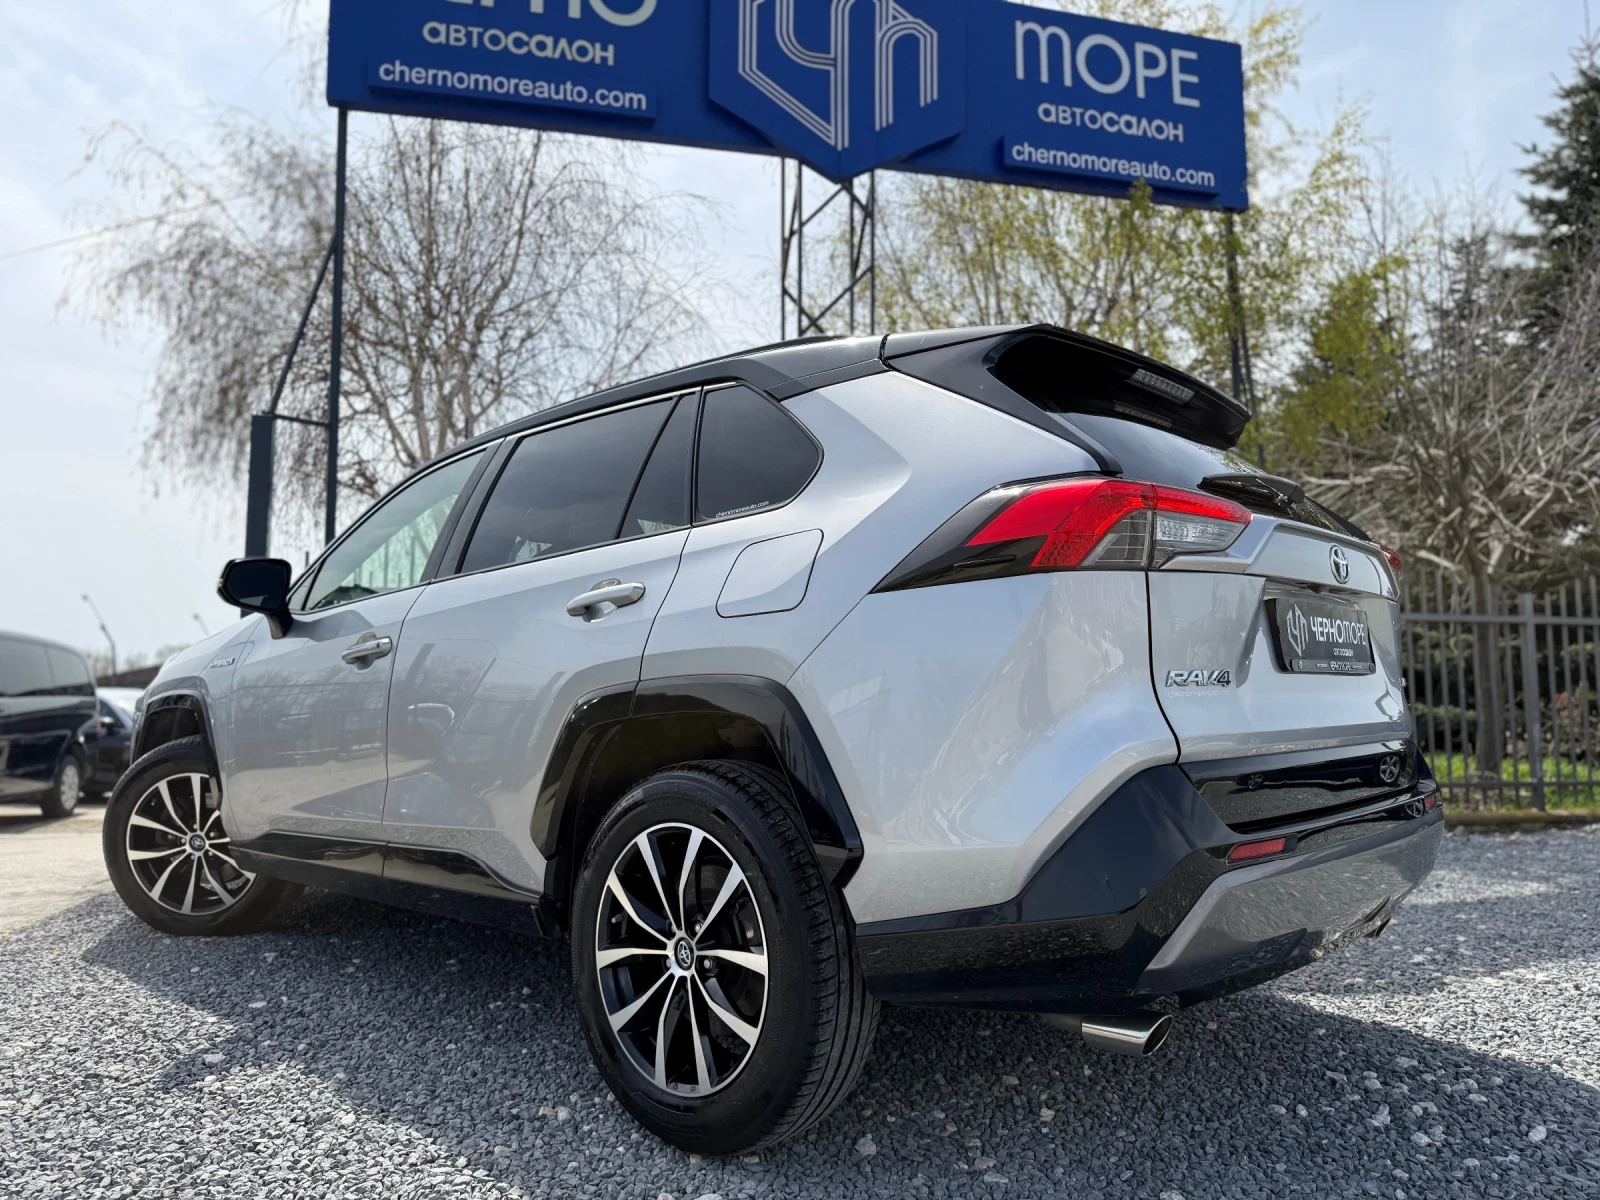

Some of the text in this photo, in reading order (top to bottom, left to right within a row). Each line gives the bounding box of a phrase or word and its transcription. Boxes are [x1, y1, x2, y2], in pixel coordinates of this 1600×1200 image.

[379, 61, 647, 110] chernomoreauto.com
[1012, 142, 1215, 187] chernomoreauto.com
[1165, 669, 1232, 688] RAV4
